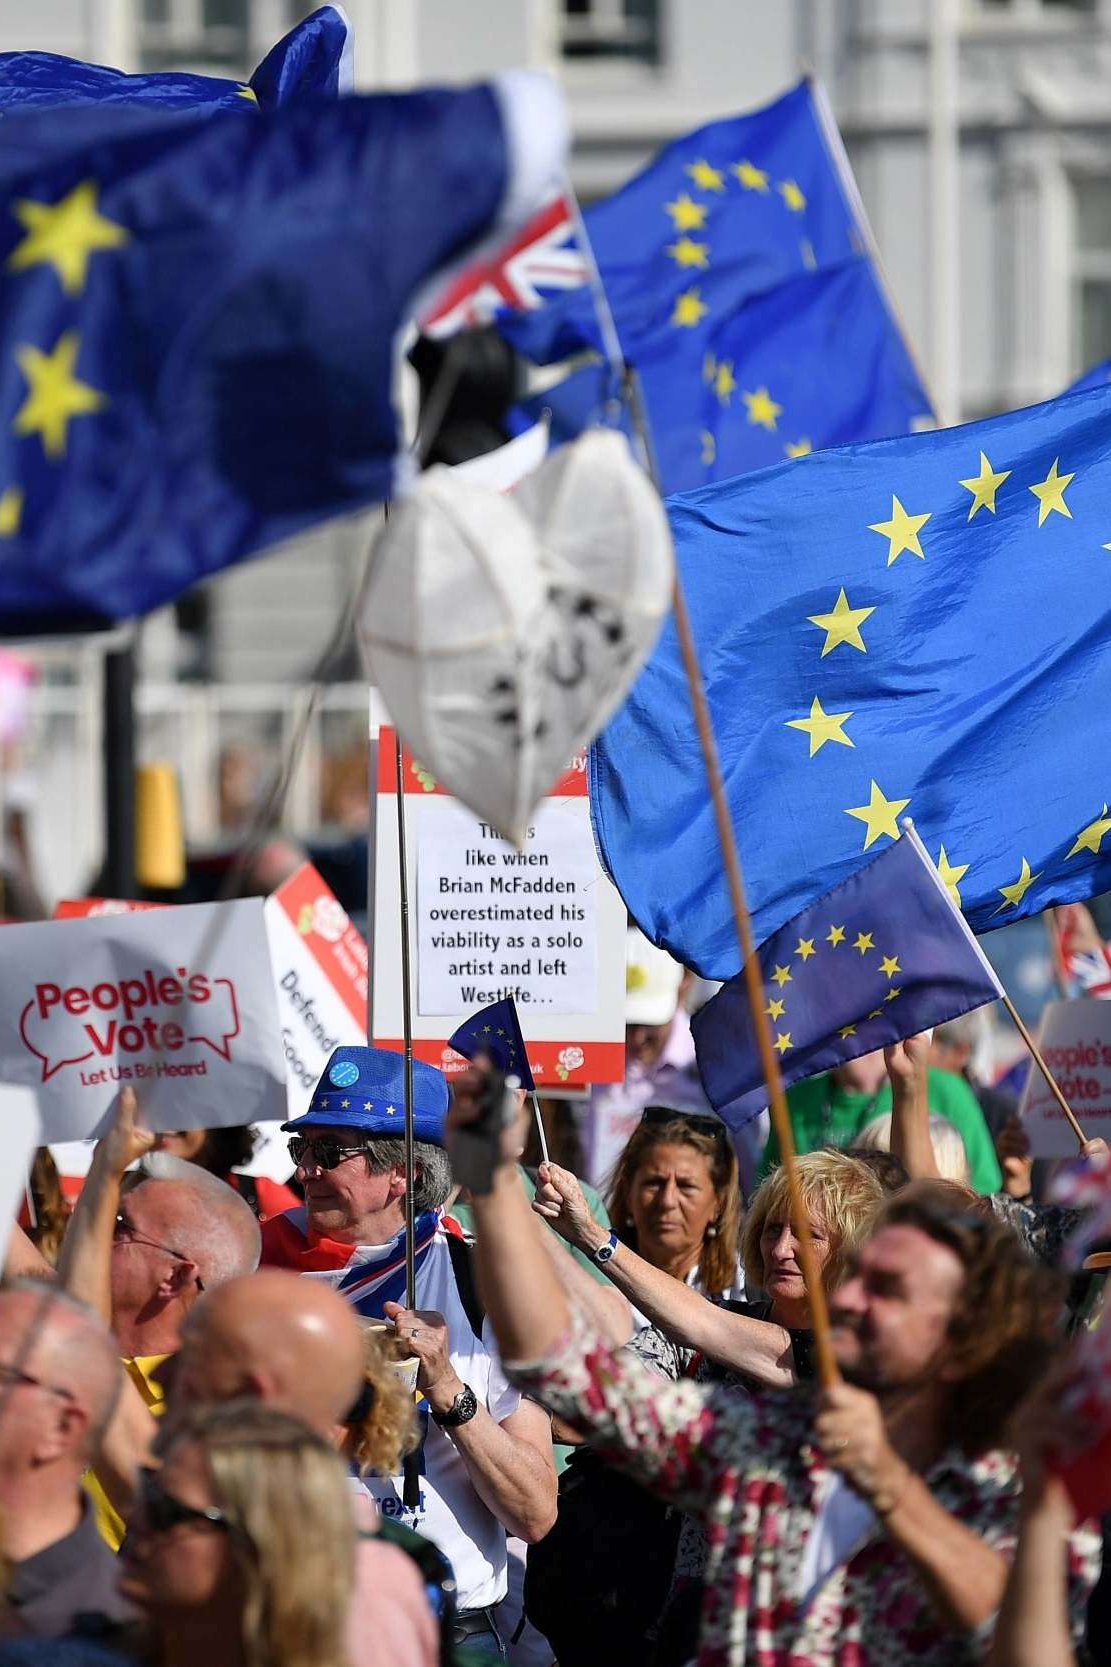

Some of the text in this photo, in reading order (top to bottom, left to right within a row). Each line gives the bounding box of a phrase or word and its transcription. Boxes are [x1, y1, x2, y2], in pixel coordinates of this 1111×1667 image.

[465, 849, 549, 866] like when
[439, 877, 576, 894] Brian McFadden
[429, 904, 585, 921] overestimated his
[431, 931, 584, 953] viability as a solo
[448, 958, 568, 975] artist and left
[35, 968, 212, 1021] People's
[280, 969, 341, 1052] Defend
[84, 1016, 185, 1056] Vote
[80, 1071, 108, 1086] Let
[110, 1064, 132, 1081] Us
[156, 1060, 208, 1078] Heard
